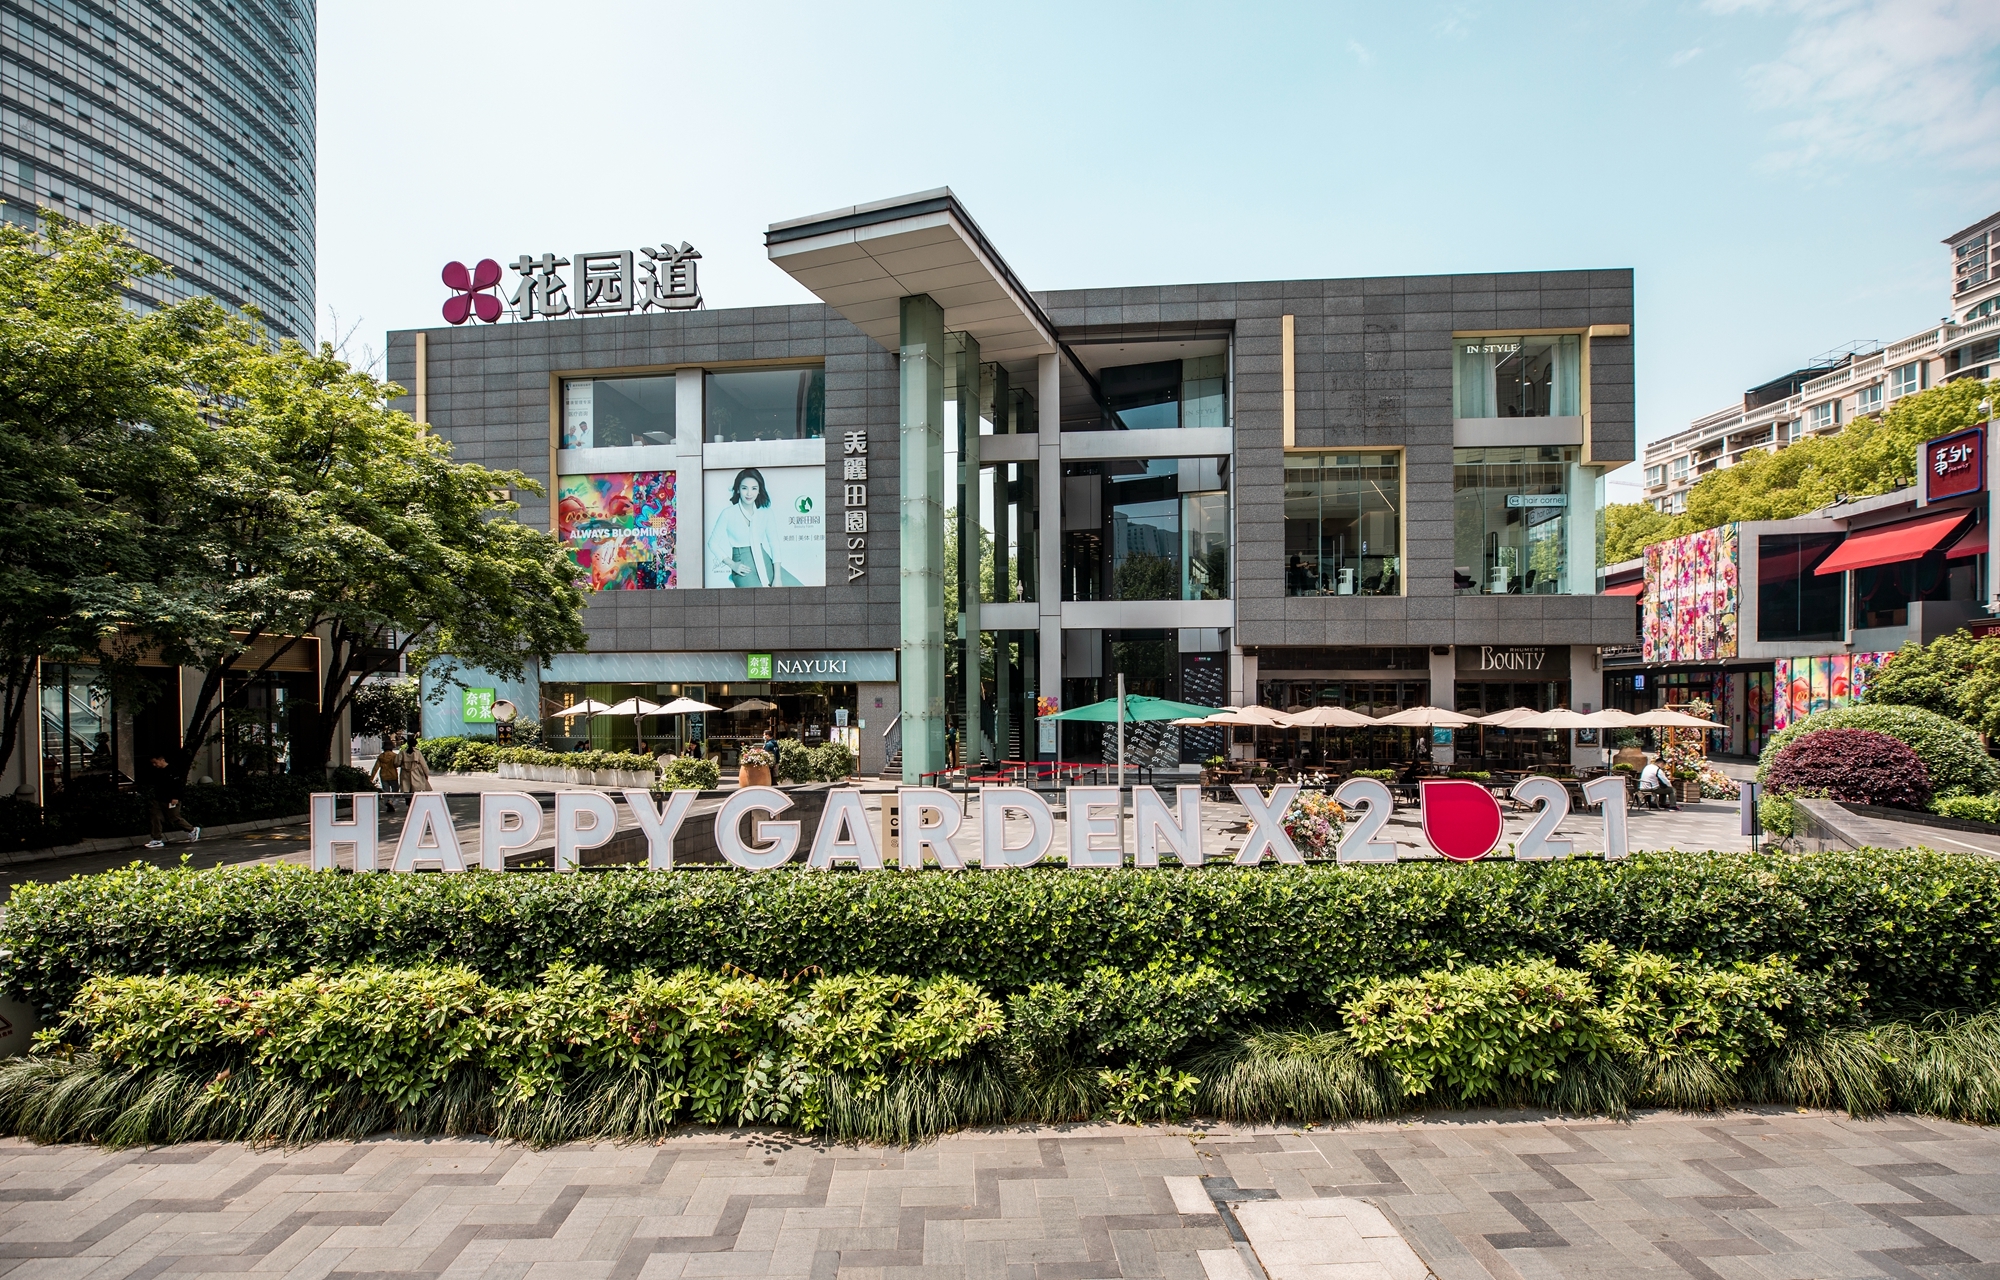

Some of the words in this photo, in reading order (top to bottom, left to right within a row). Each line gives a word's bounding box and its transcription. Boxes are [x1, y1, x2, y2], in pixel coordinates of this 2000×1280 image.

[509, 241, 703, 320] 花园道
[1467, 345, 1479, 354] IN
[569, 528, 611, 540] ALWAYS
[611, 526, 668, 538] BLOOMING
[776, 659, 847, 674] NAYUKI
[1231, 783, 1306, 865] X
